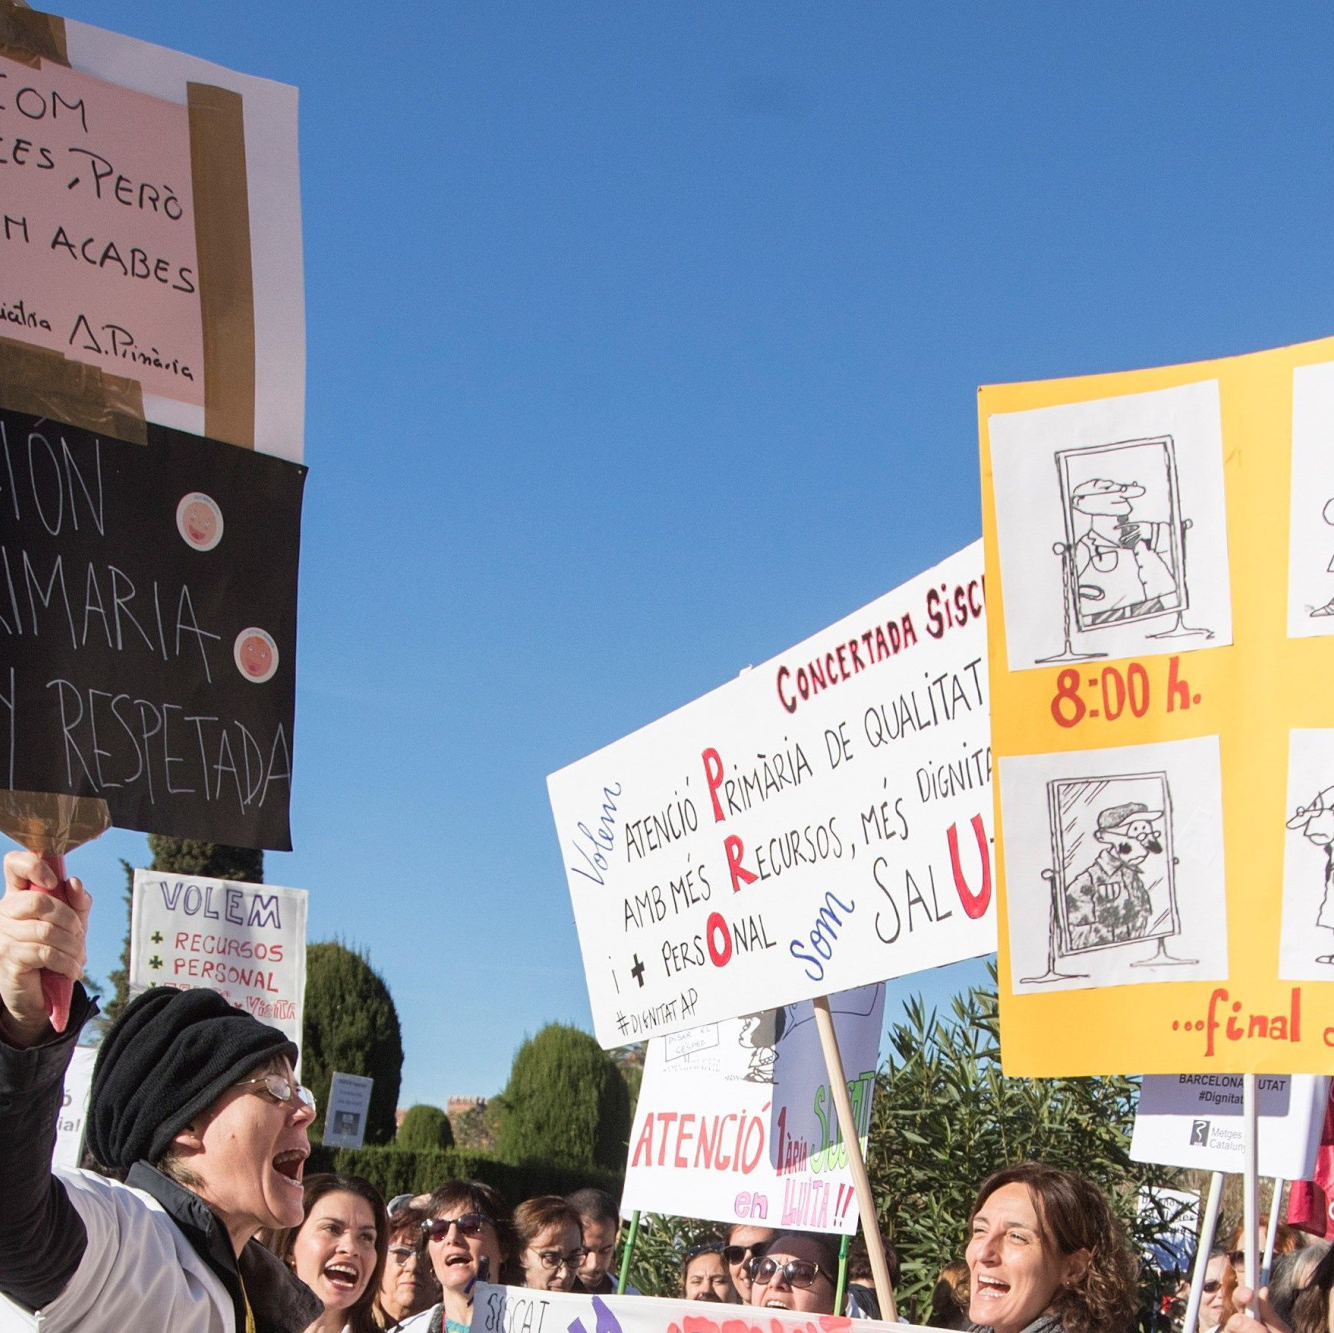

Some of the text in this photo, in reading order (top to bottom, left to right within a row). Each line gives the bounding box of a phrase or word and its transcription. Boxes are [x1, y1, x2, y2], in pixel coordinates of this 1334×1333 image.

[50, 227, 196, 293] ACABES
[775, 612, 919, 715] CONCERTADA
[1050, 665, 1151, 728] 8:00
[46, 678, 292, 815] RESPETADA
[824, 721, 854, 770] DE
[624, 885, 667, 932] AMB
[669, 853, 711, 914] MÉS
[860, 777, 909, 845] MÉS
[873, 813, 995, 944] SALU
[159, 881, 281, 929] VOLEM
[174, 958, 279, 993] PERSONAL
[175, 932, 284, 962] RECURSOS
[661, 911, 777, 977] PERSONAL
[1258, 1079, 1286, 1091] UTAT
[734, 1190, 768, 1220] en
